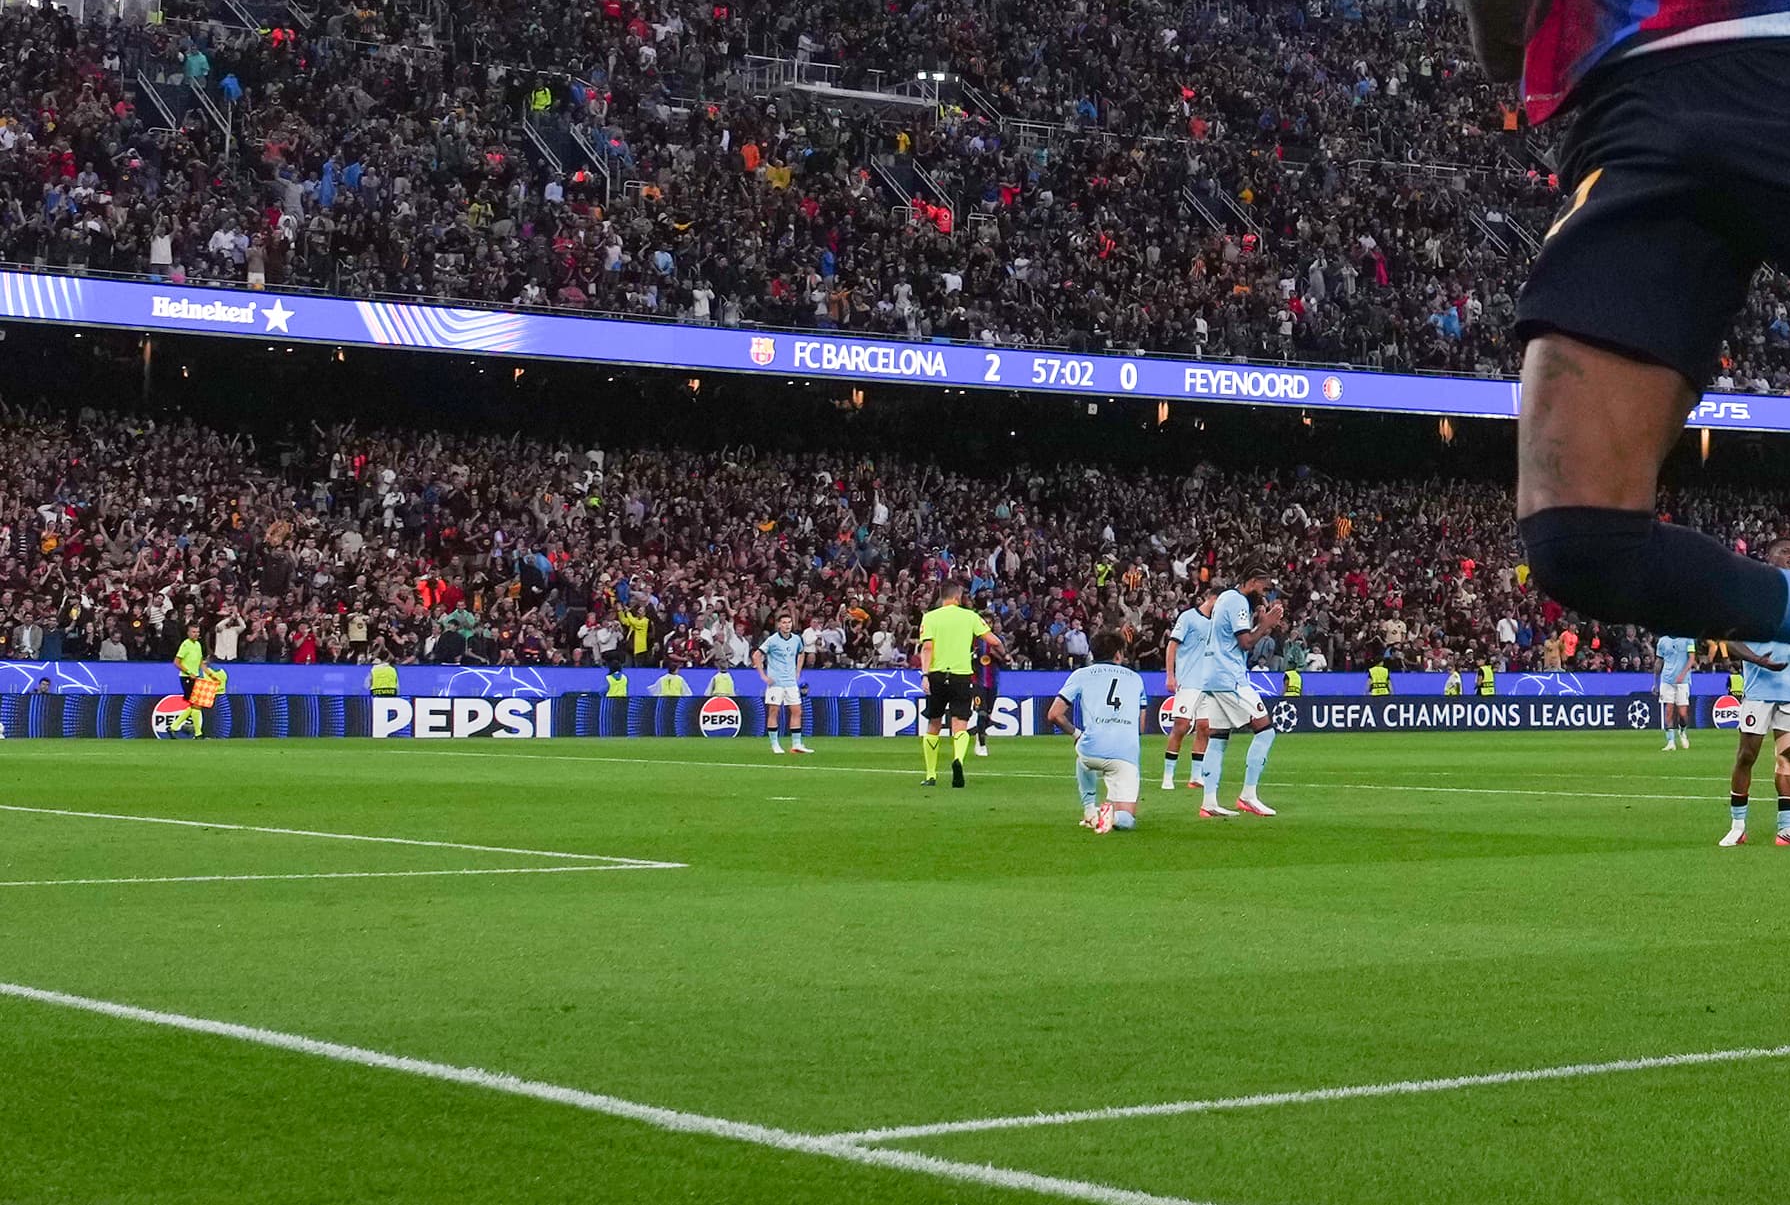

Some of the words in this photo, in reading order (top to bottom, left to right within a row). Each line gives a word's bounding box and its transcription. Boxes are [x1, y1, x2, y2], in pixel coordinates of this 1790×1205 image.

[151, 296, 256, 323] Heineken
[794, 341, 820, 369] FC
[821, 344, 947, 377] BARCELONA
[984, 353, 1001, 382] 2
[1031, 358, 1094, 386] 57:02
[1120, 363, 1138, 390] 0
[1184, 368, 1310, 399] FEYENOORD
[1106, 678, 1122, 712] 4
[373, 698, 551, 738] PEPSI
[702, 715, 739, 725] PEPSI
[1312, 705, 1376, 727] UEFA
[1383, 704, 1521, 727] CHAMPIONS
[1530, 704, 1615, 727] LEAGUE
[1715, 710, 1739, 719] PEPS
